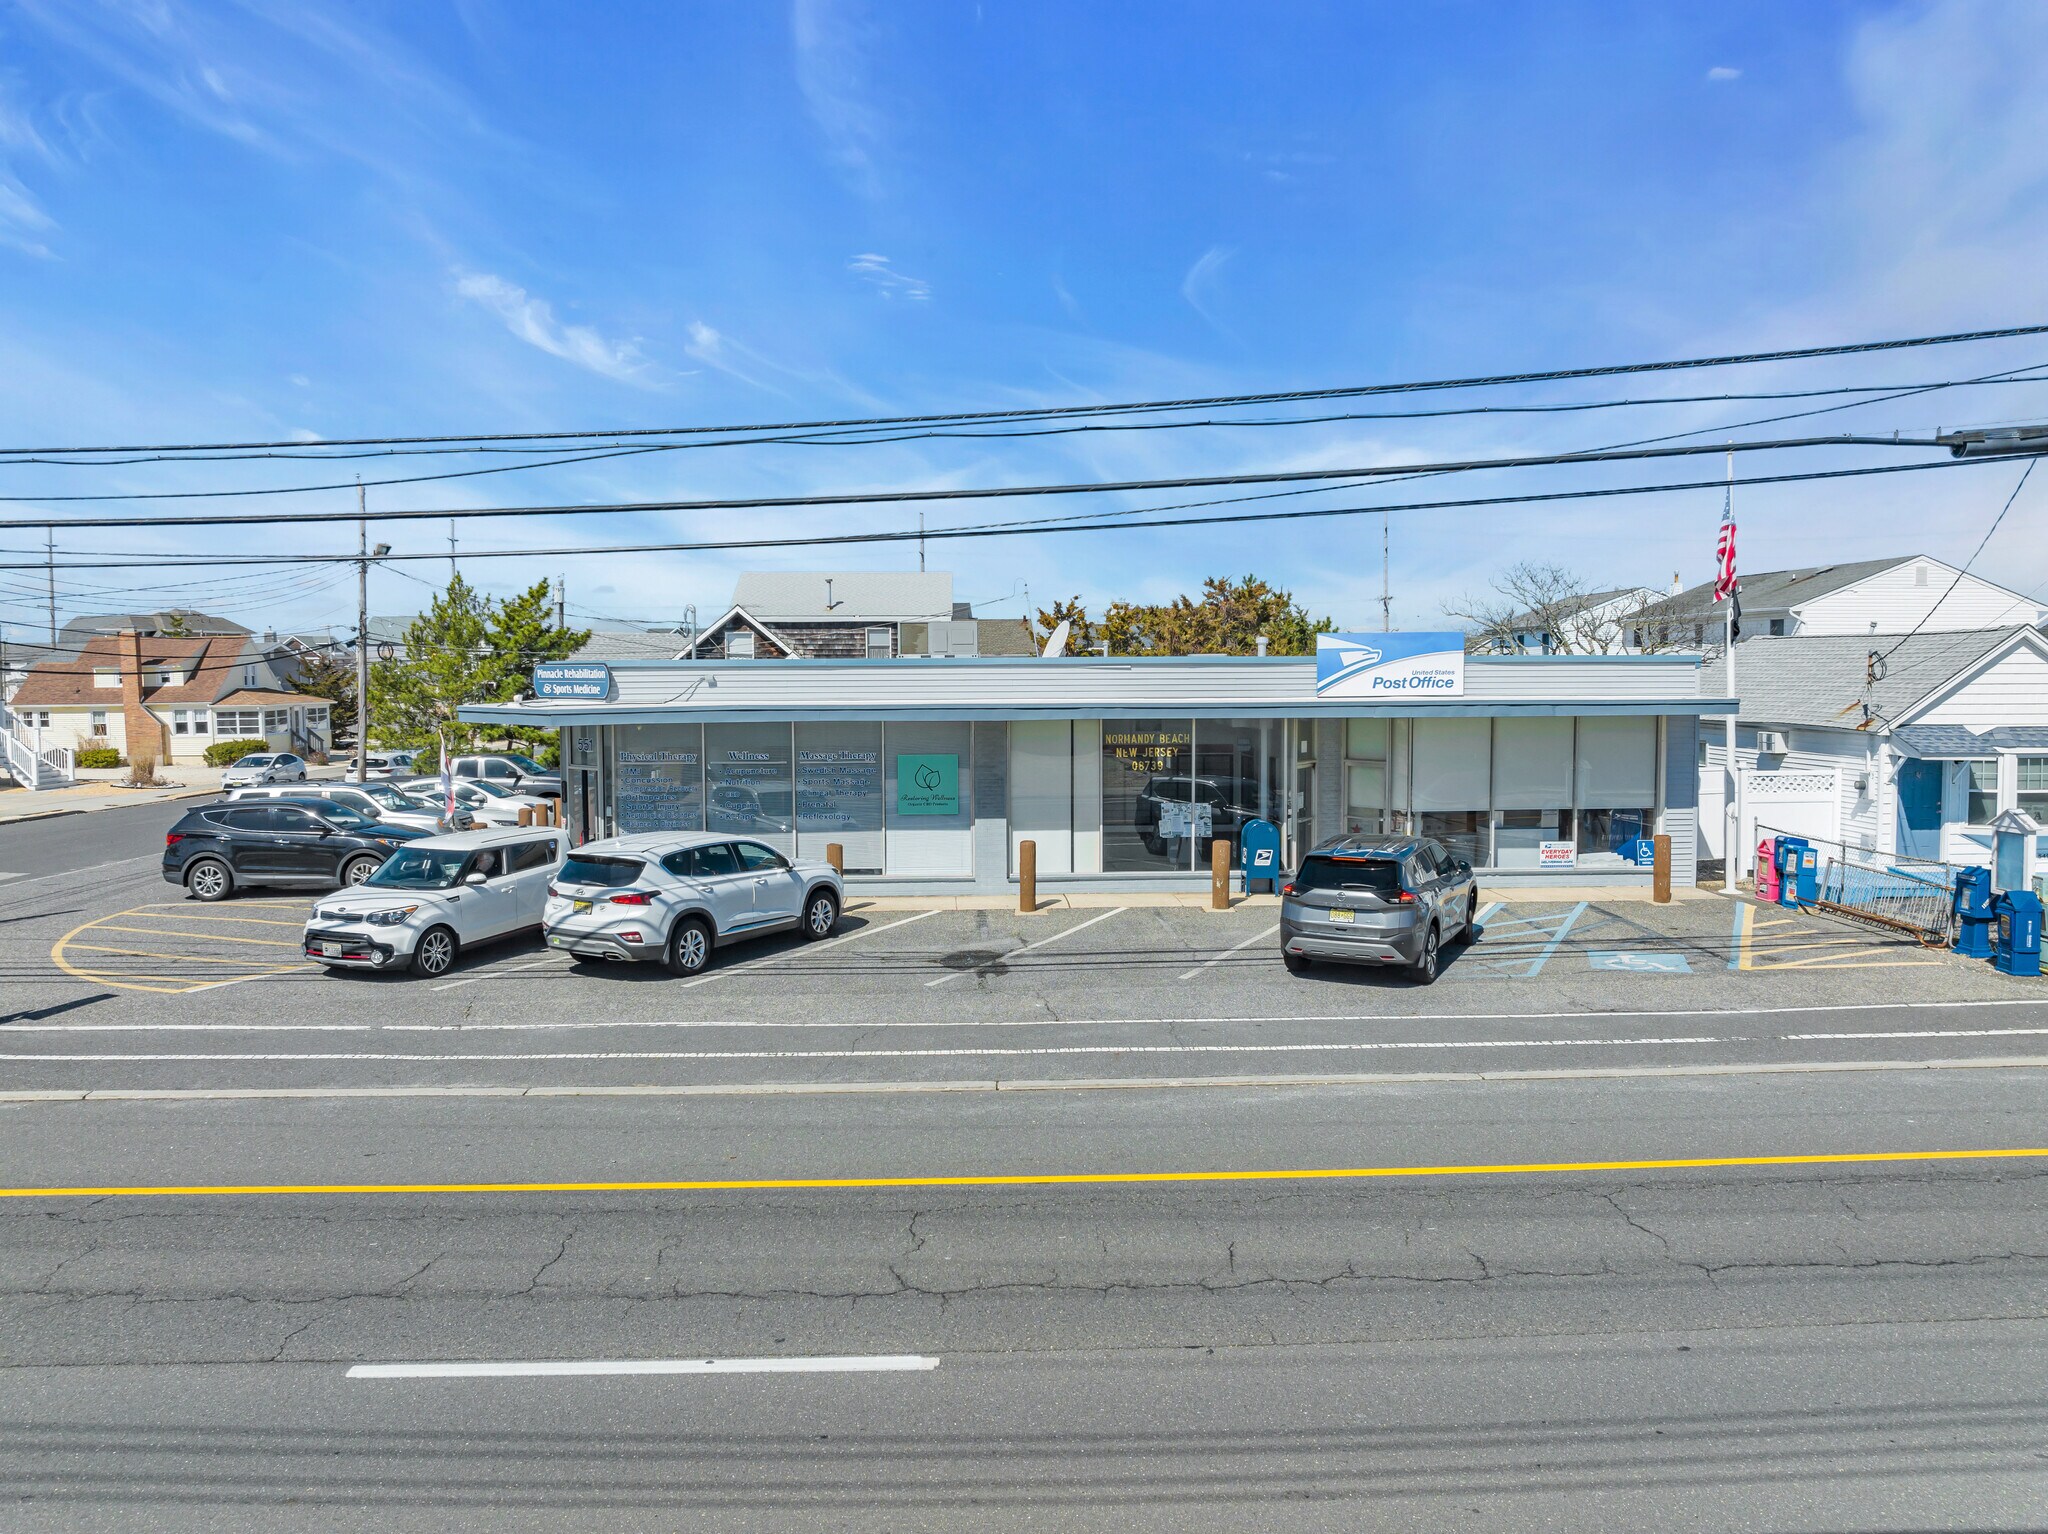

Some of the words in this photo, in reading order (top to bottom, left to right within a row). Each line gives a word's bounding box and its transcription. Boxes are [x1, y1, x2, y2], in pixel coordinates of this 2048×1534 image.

[537, 669, 563, 679] Pinnacle
[564, 669, 606, 679] Rehabilitation
[1372, 677, 1407, 689] Post
[1409, 676, 1455, 689] Office
[543, 683, 552, 694] &
[552, 684, 573, 695] Sports
[573, 684, 601, 694] Medicine
[1105, 734, 1155, 744] NORMANDY
[1159, 733, 1190, 744] BEACH
[577, 738, 594, 752] 551
[619, 751, 658, 763] Physical
[659, 751, 698, 763] Therapy
[728, 751, 770, 761] Wellness
[800, 751, 838, 762] Massage
[839, 751, 876, 762] Therapy
[1115, 747, 1138, 758] NEW
[1142, 747, 1179, 757] JERSEY
[801, 767, 836, 775] Swedish
[839, 767, 877, 776] Massage
[725, 778, 761, 786] Nutrition
[802, 778, 830, 787] Sports
[833, 778, 871, 787] Massage
[625, 794, 677, 802] Orthopedics
[835, 789, 868, 798] Therapy
[901, 794, 930, 802] Restoring
[626, 803, 655, 812] Sports
[657, 803, 681, 812] Injury
[725, 801, 760, 811] Cupping
[802, 800, 836, 808] Prenatal
[802, 812, 851, 821] Reflexology
